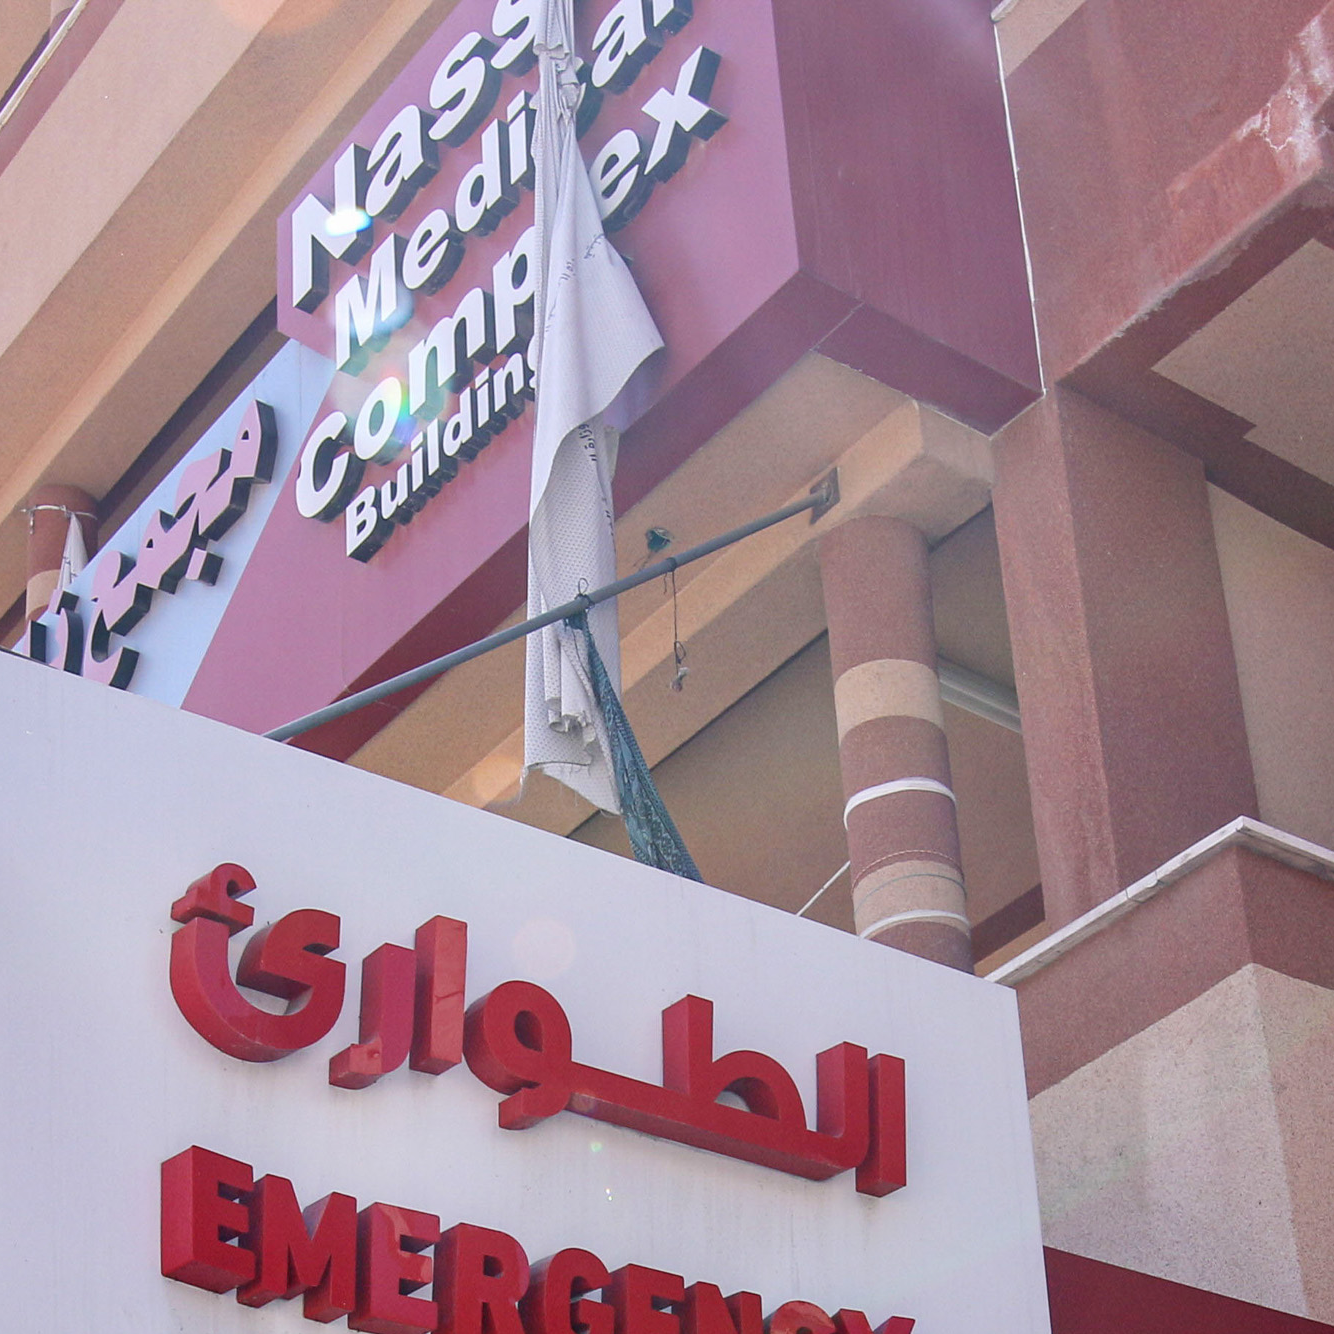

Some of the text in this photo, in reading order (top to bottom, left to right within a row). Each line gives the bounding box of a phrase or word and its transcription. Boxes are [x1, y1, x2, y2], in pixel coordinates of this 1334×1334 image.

[290, 0, 538, 312] Nass
[295, 45, 721, 522] Compex
[169, 861, 907, 1198] الطوارئ
